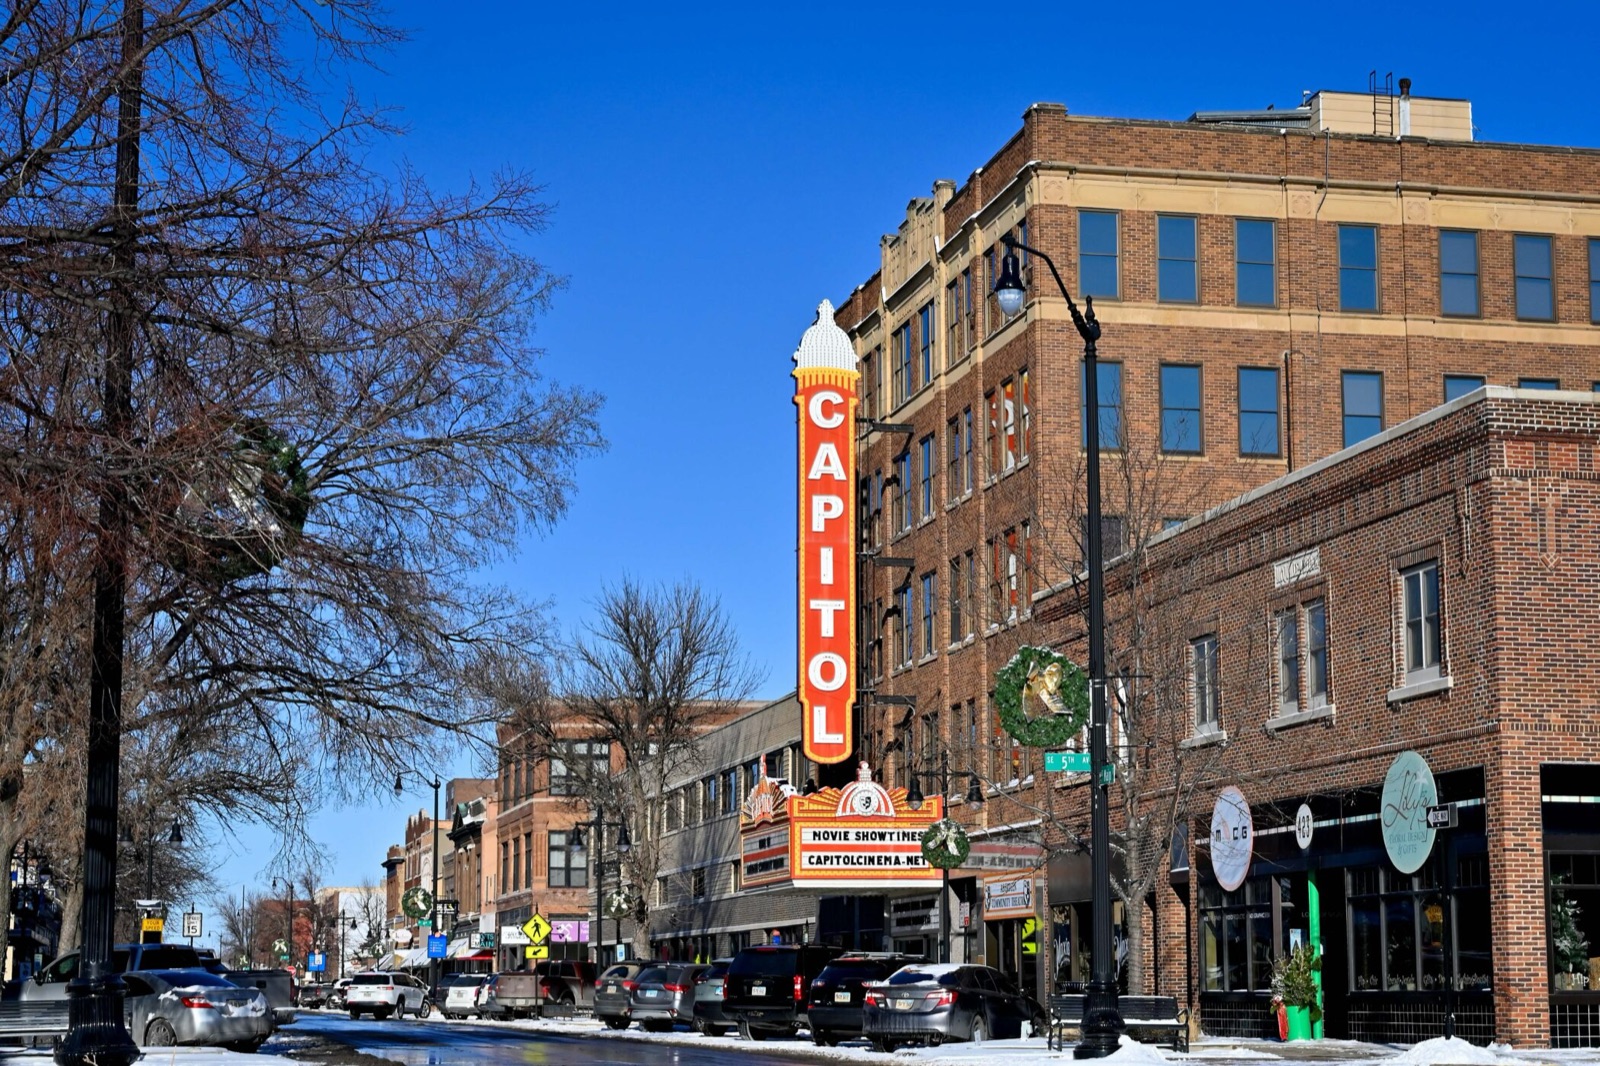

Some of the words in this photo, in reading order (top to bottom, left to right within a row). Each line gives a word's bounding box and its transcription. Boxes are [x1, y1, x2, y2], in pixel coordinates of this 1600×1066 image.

[808, 391, 847, 744] CAPITOL
[1047, 756, 1054, 764] SE
[1062, 756, 1075, 769] 5TH
[1298, 815, 1310, 838] 423
[812, 830, 850, 841] MOVIE
[854, 831, 923, 842] SHOWTIMES
[187, 926, 198, 934] 15
